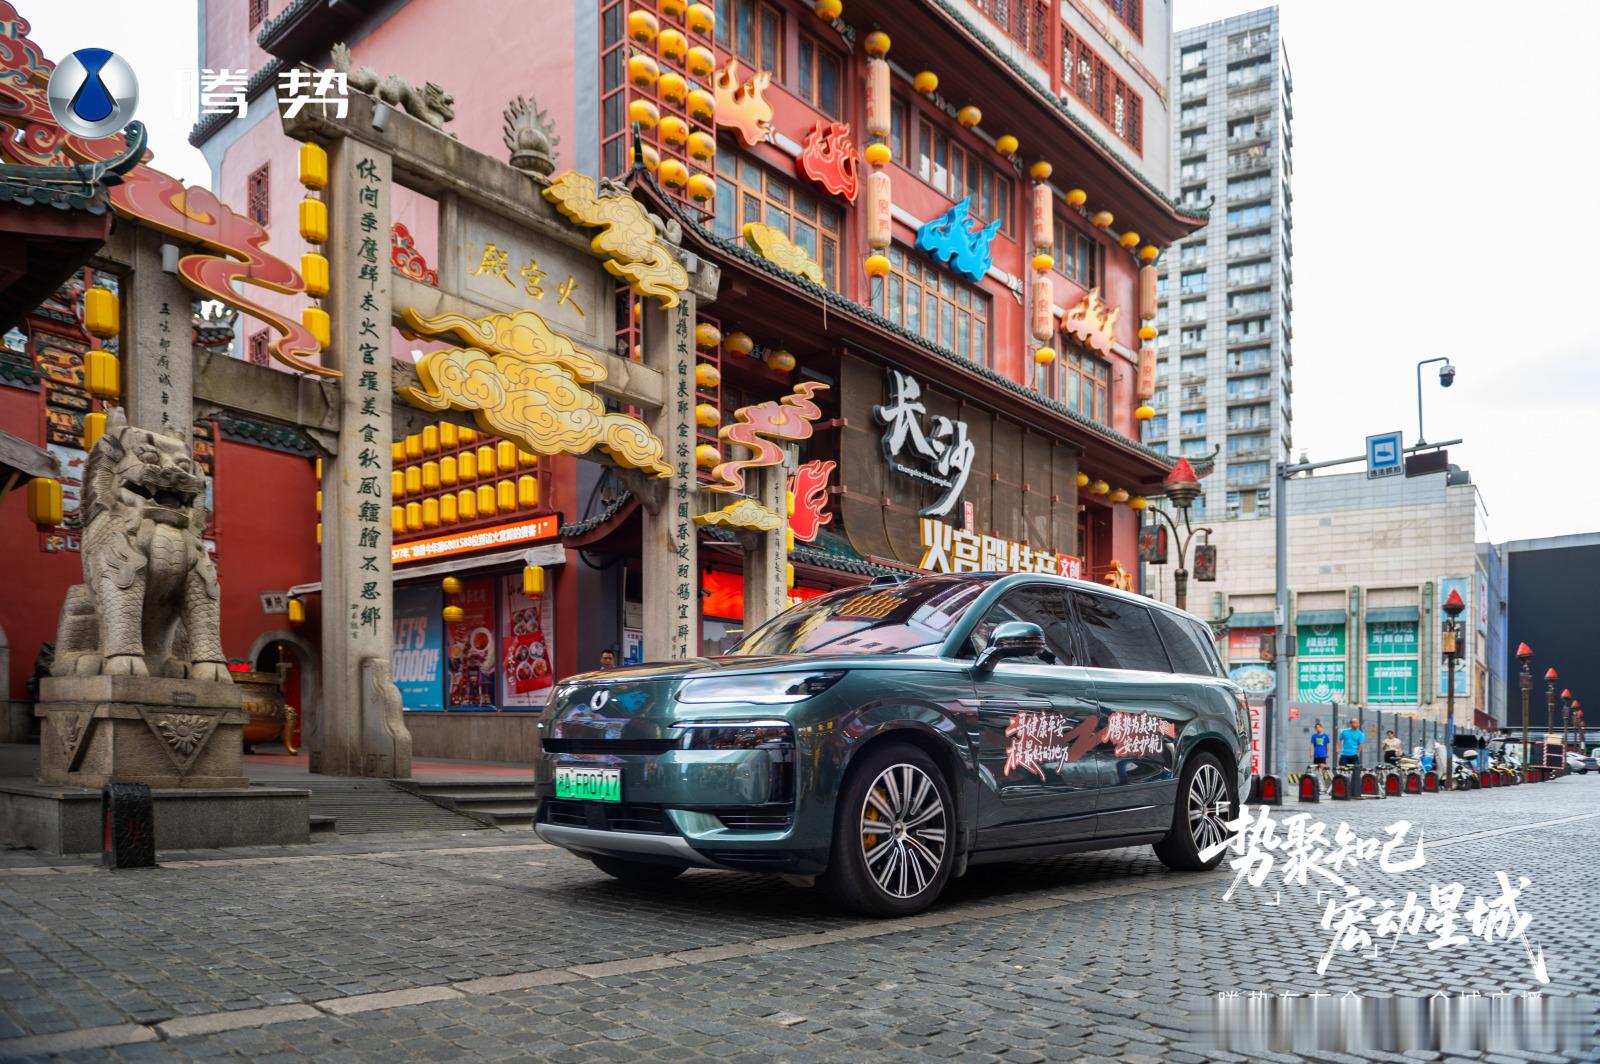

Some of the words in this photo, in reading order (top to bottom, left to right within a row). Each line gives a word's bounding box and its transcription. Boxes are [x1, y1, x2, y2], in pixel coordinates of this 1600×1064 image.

[919, 517, 1057, 575] 火宫殿特产
